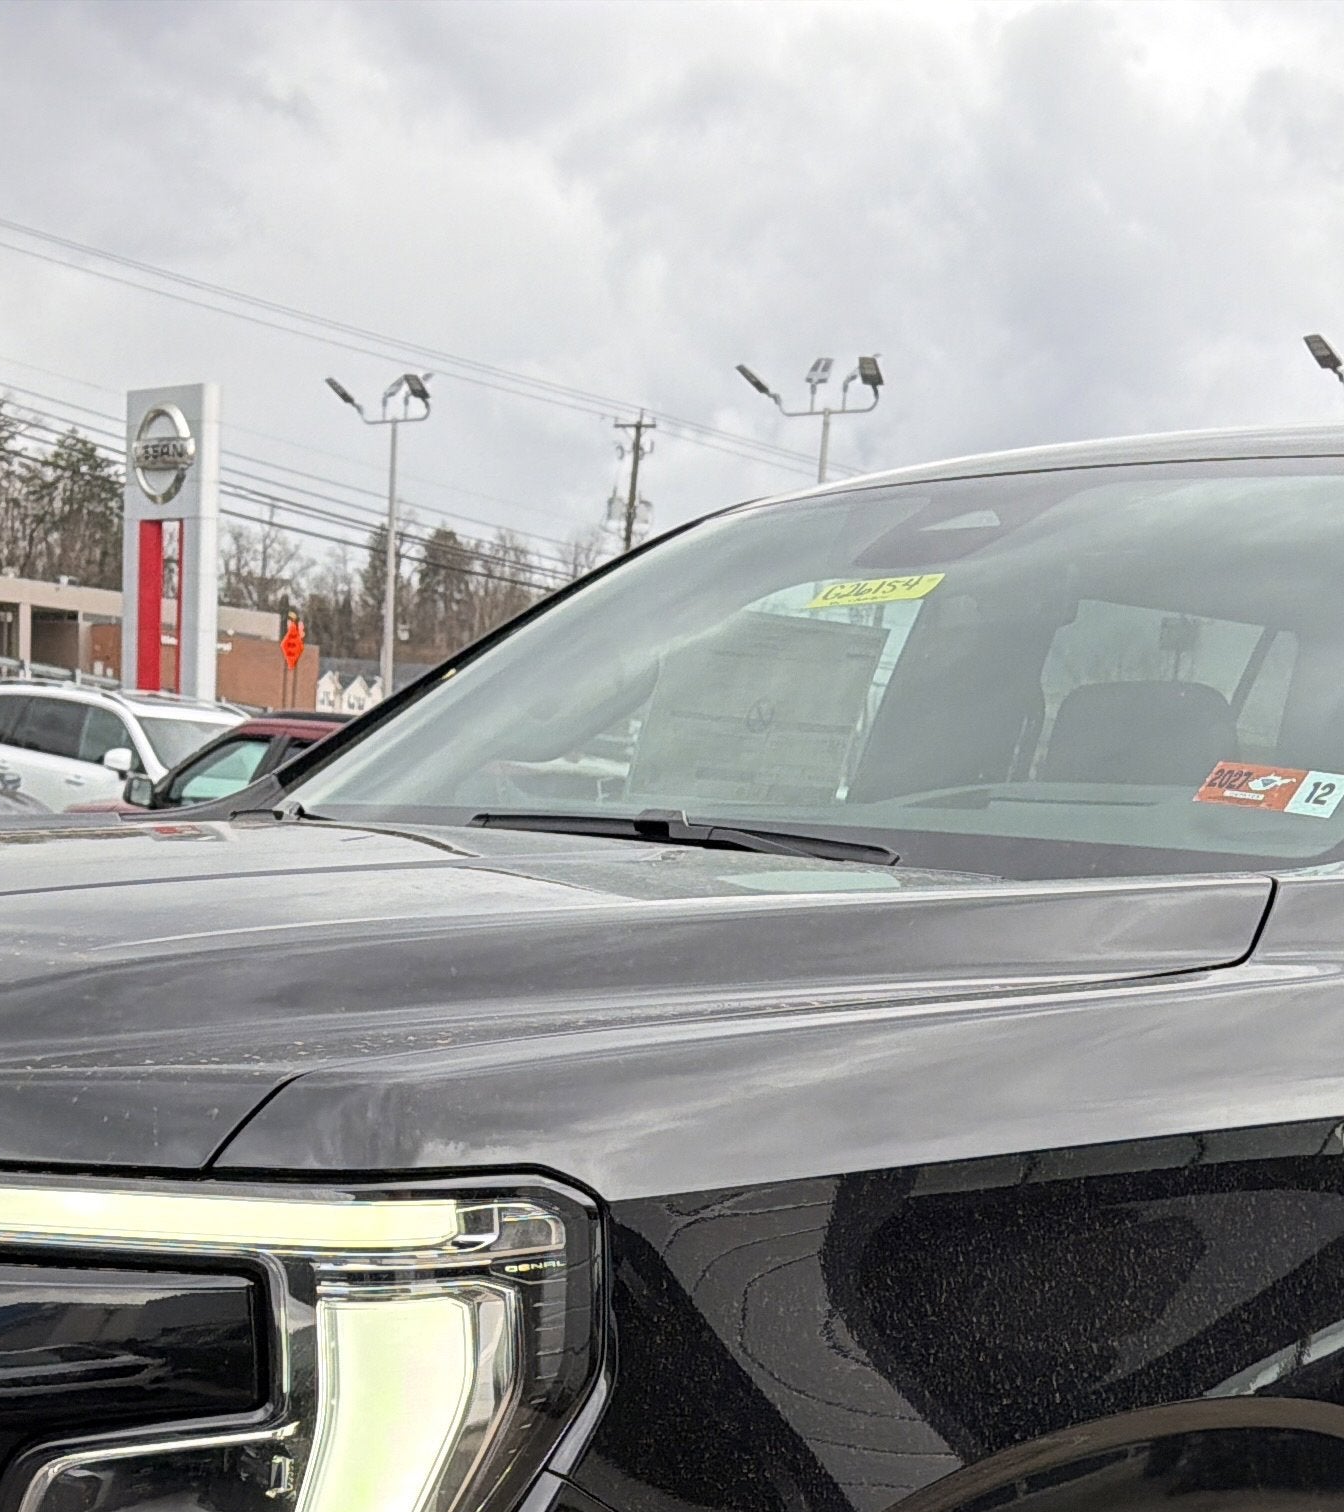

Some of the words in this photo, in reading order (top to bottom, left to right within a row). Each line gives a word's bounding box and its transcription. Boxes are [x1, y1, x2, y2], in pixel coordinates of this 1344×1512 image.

[821, 575, 924, 600] G26154
[1207, 768, 1253, 790] 2027
[1304, 781, 1336, 806] 12
[504, 1260, 567, 1273] DENAL
